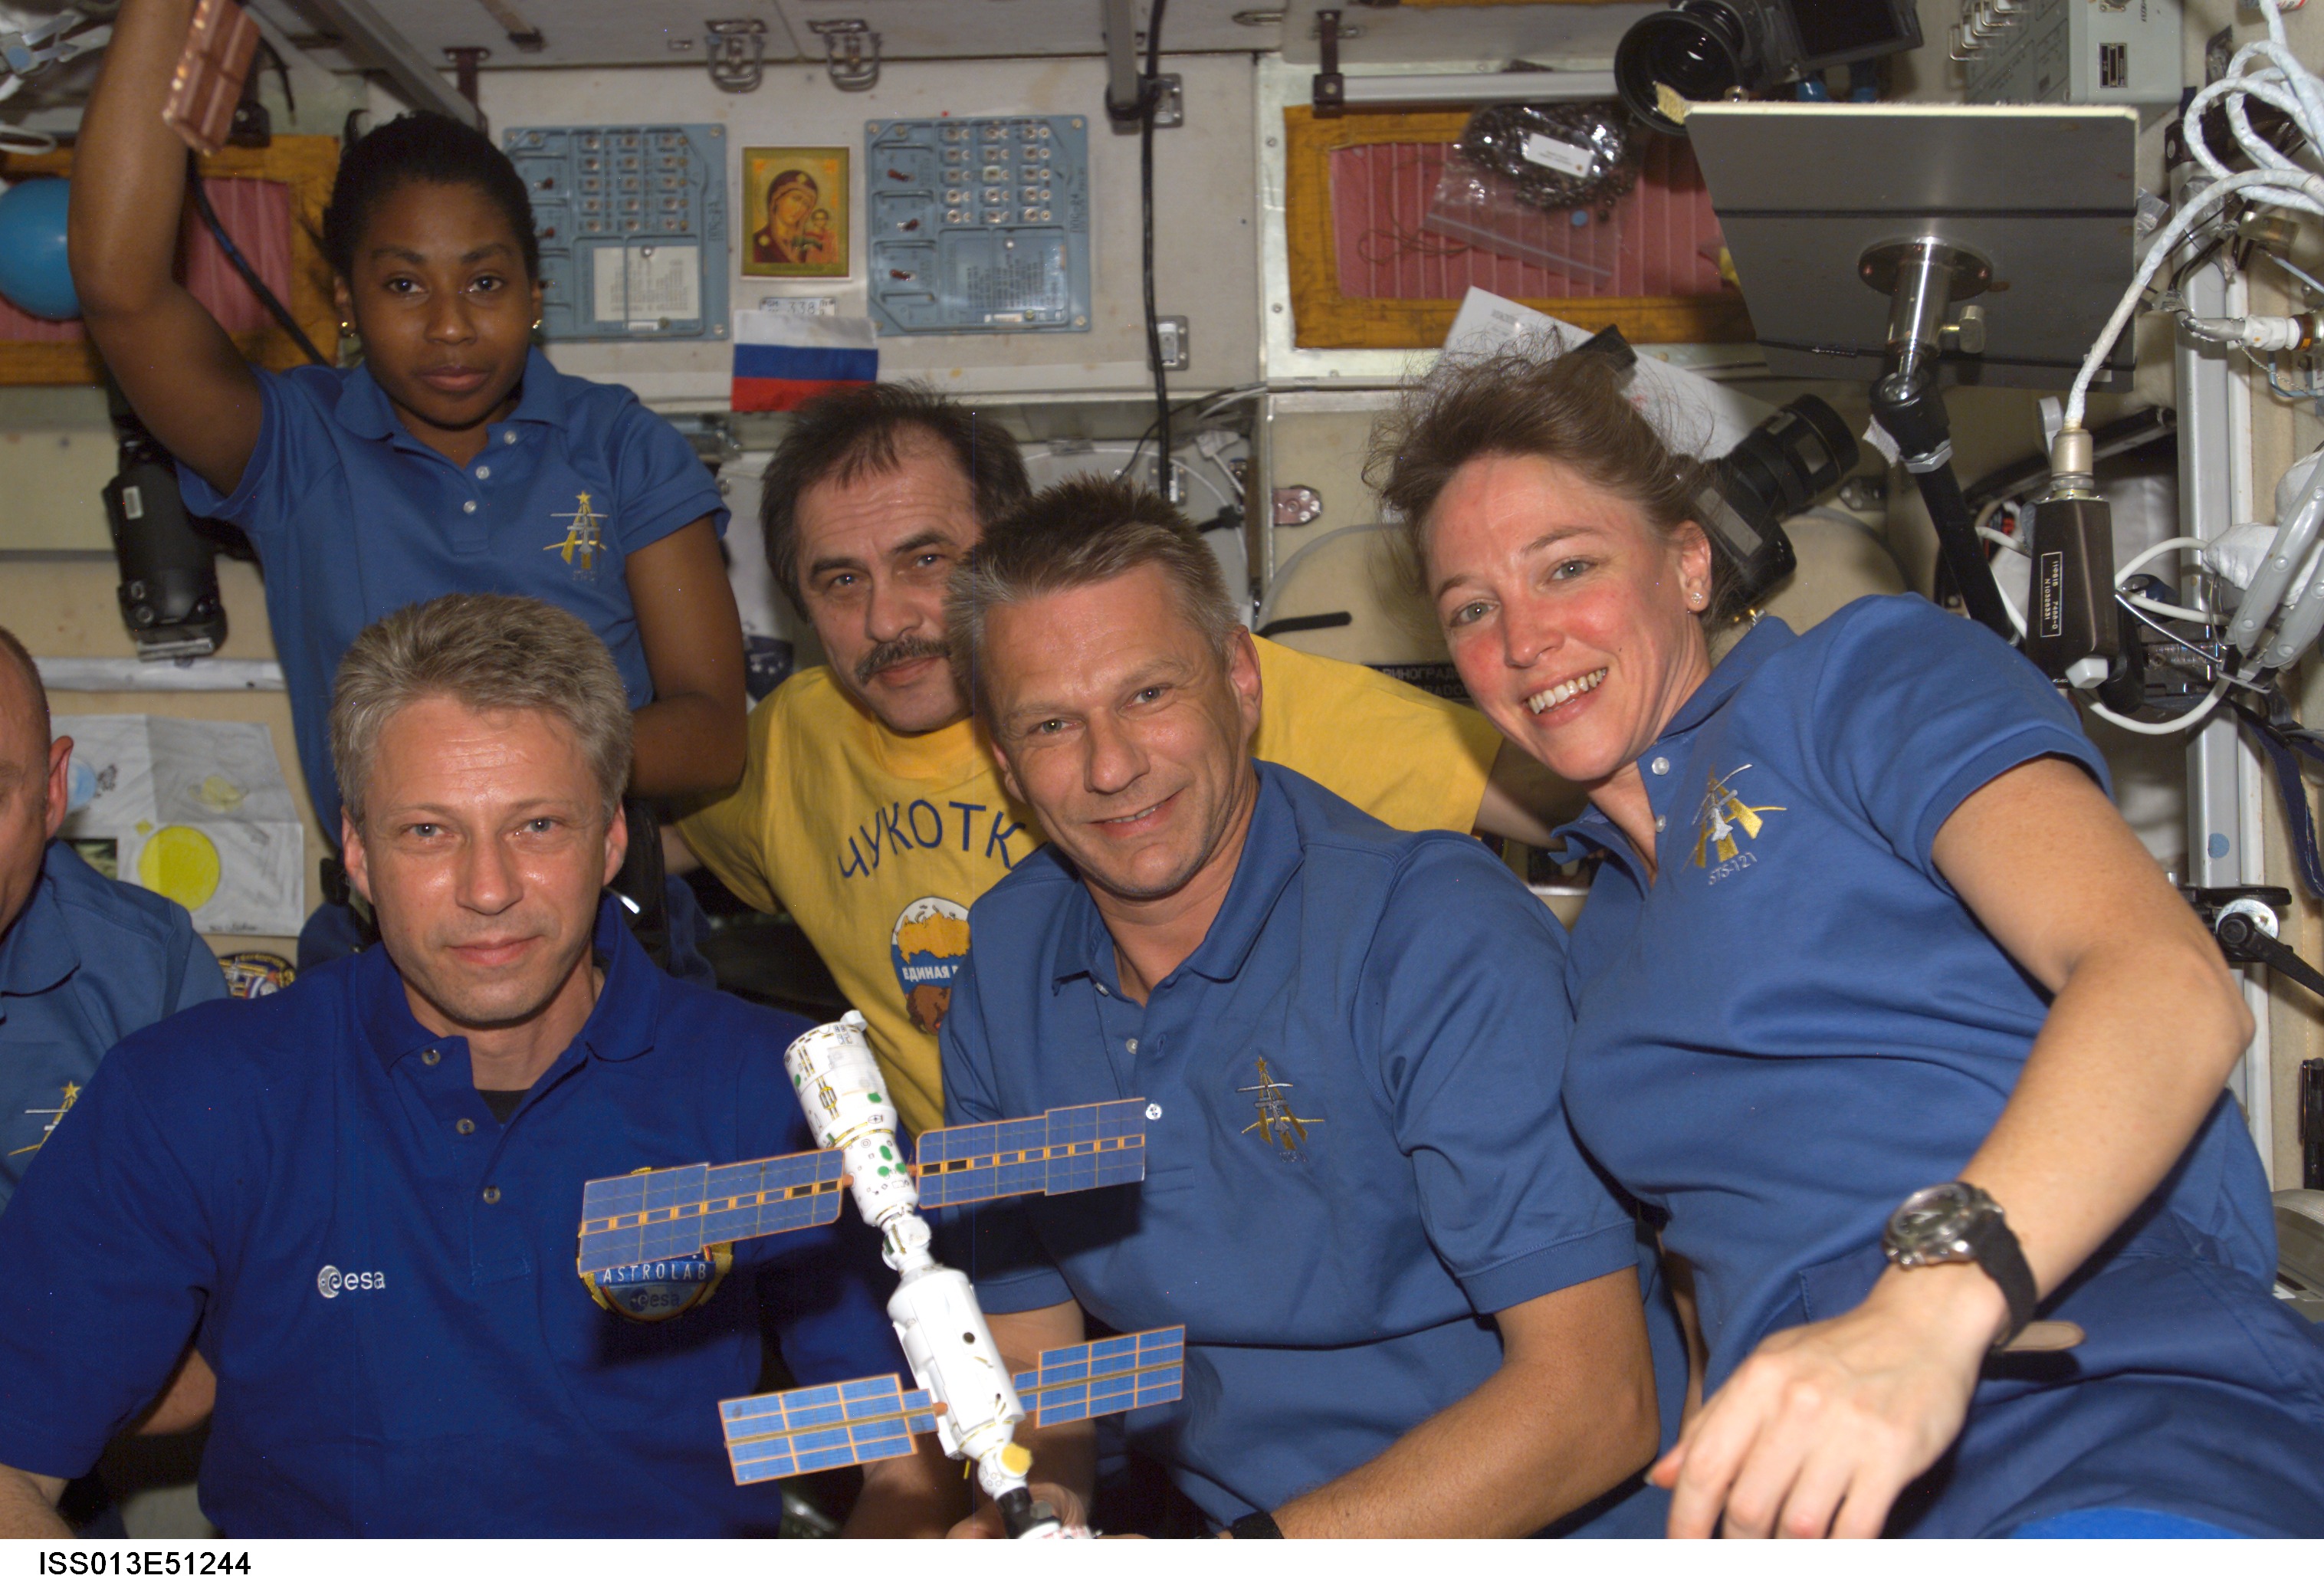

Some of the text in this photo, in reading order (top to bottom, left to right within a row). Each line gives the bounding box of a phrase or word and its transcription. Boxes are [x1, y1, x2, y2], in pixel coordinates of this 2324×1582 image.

[1383, 667, 1457, 681] ВИНОГРАД
[838, 799, 1026, 878] ЧУКОТК
[1708, 852, 1758, 885] STS-121
[902, 966, 950, 982] ЕДИНАЯ
[344, 1271, 386, 1290] esa
[603, 1263, 707, 1283] ASTROLAB
